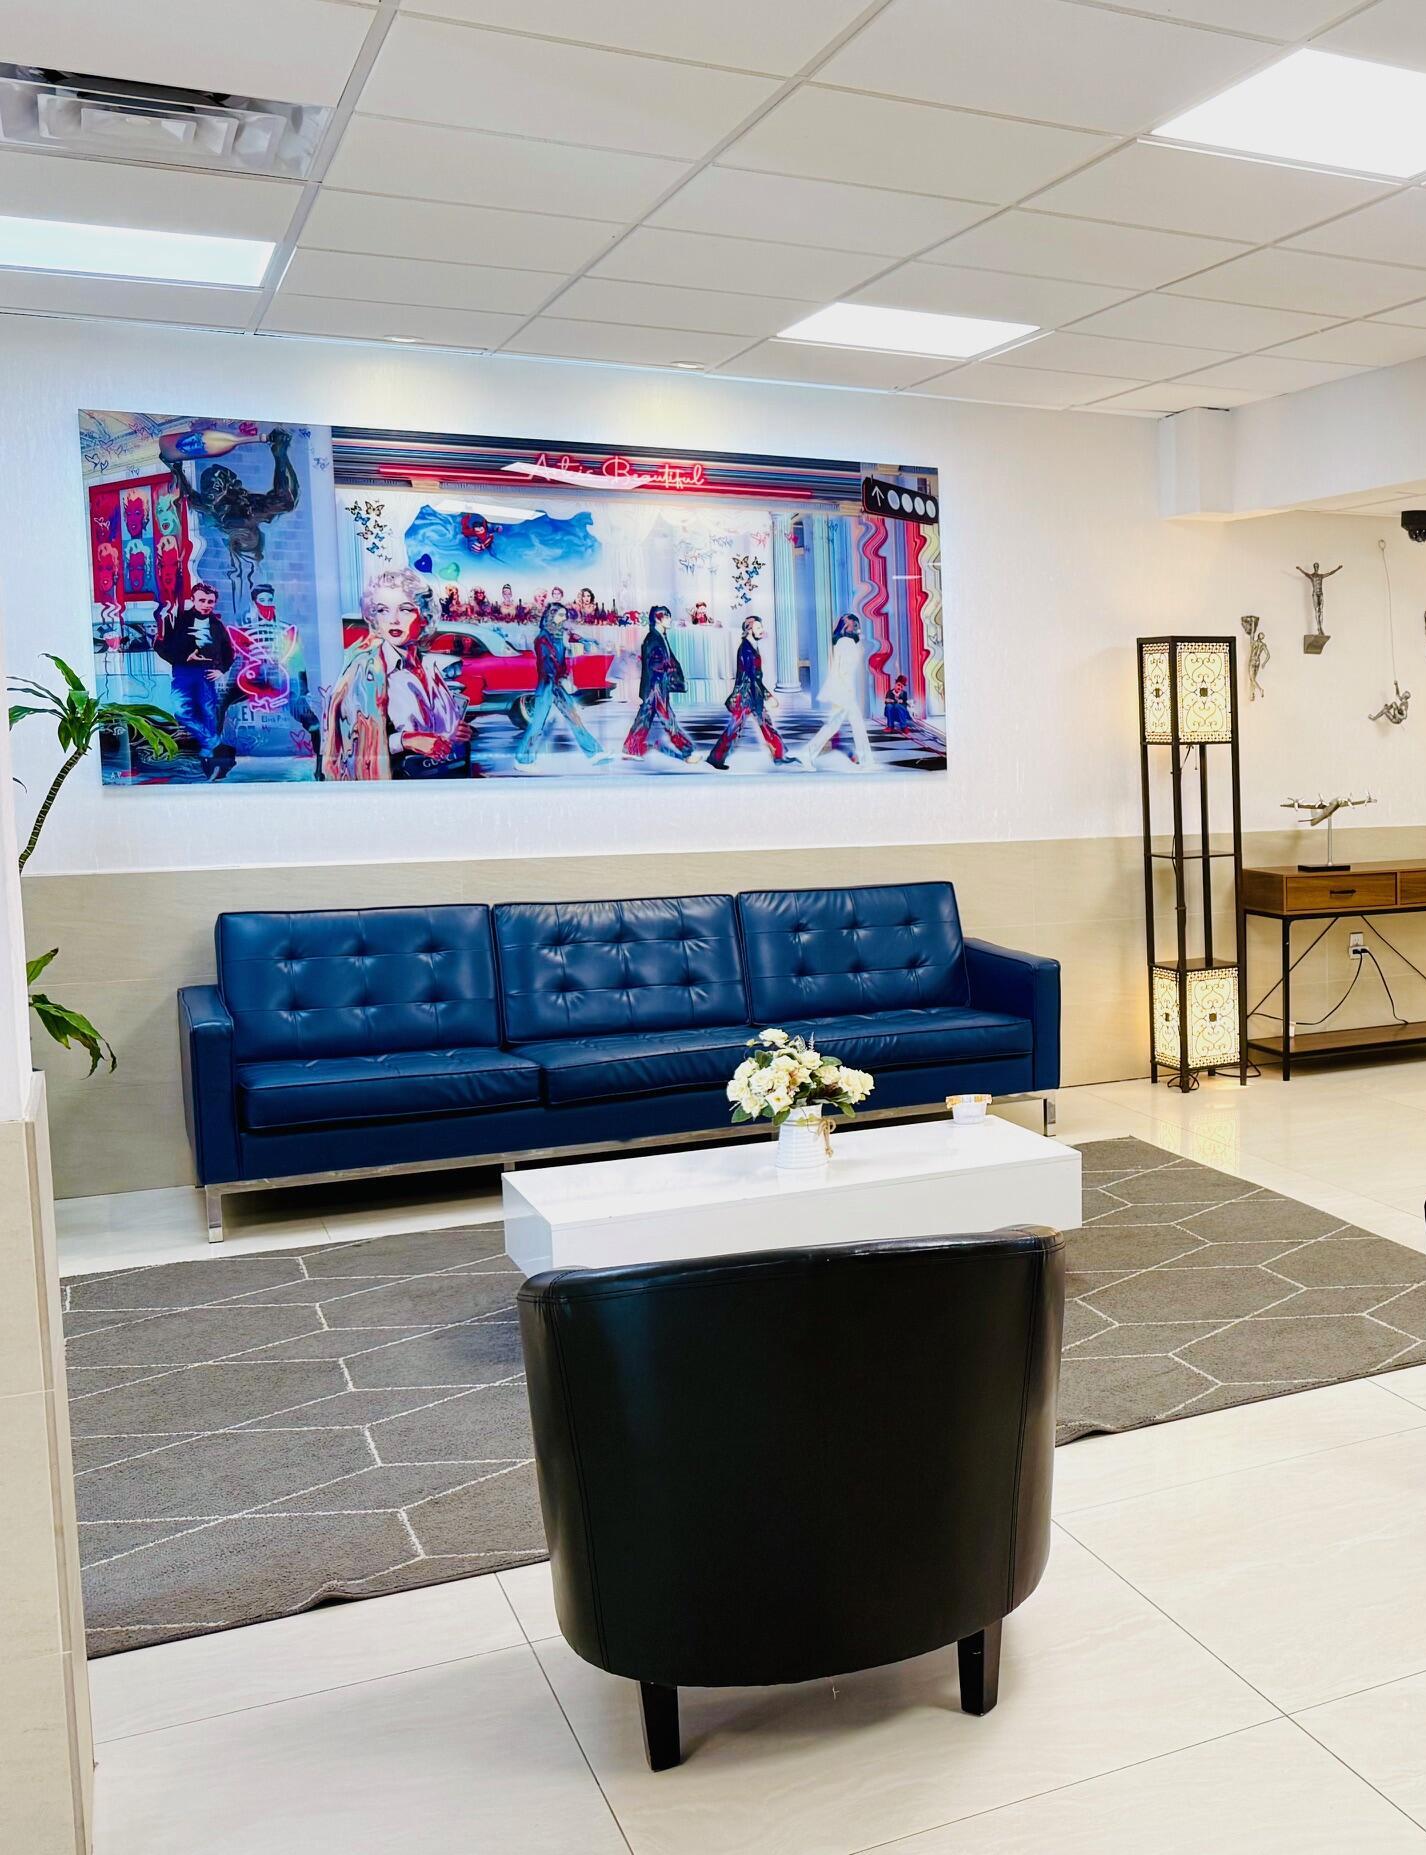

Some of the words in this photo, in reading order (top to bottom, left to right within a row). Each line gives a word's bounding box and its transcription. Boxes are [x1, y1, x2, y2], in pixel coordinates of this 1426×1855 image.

[528, 453, 581, 482] At
[602, 455, 705, 489] Beautiful
[422, 751, 457, 768] GUCI
